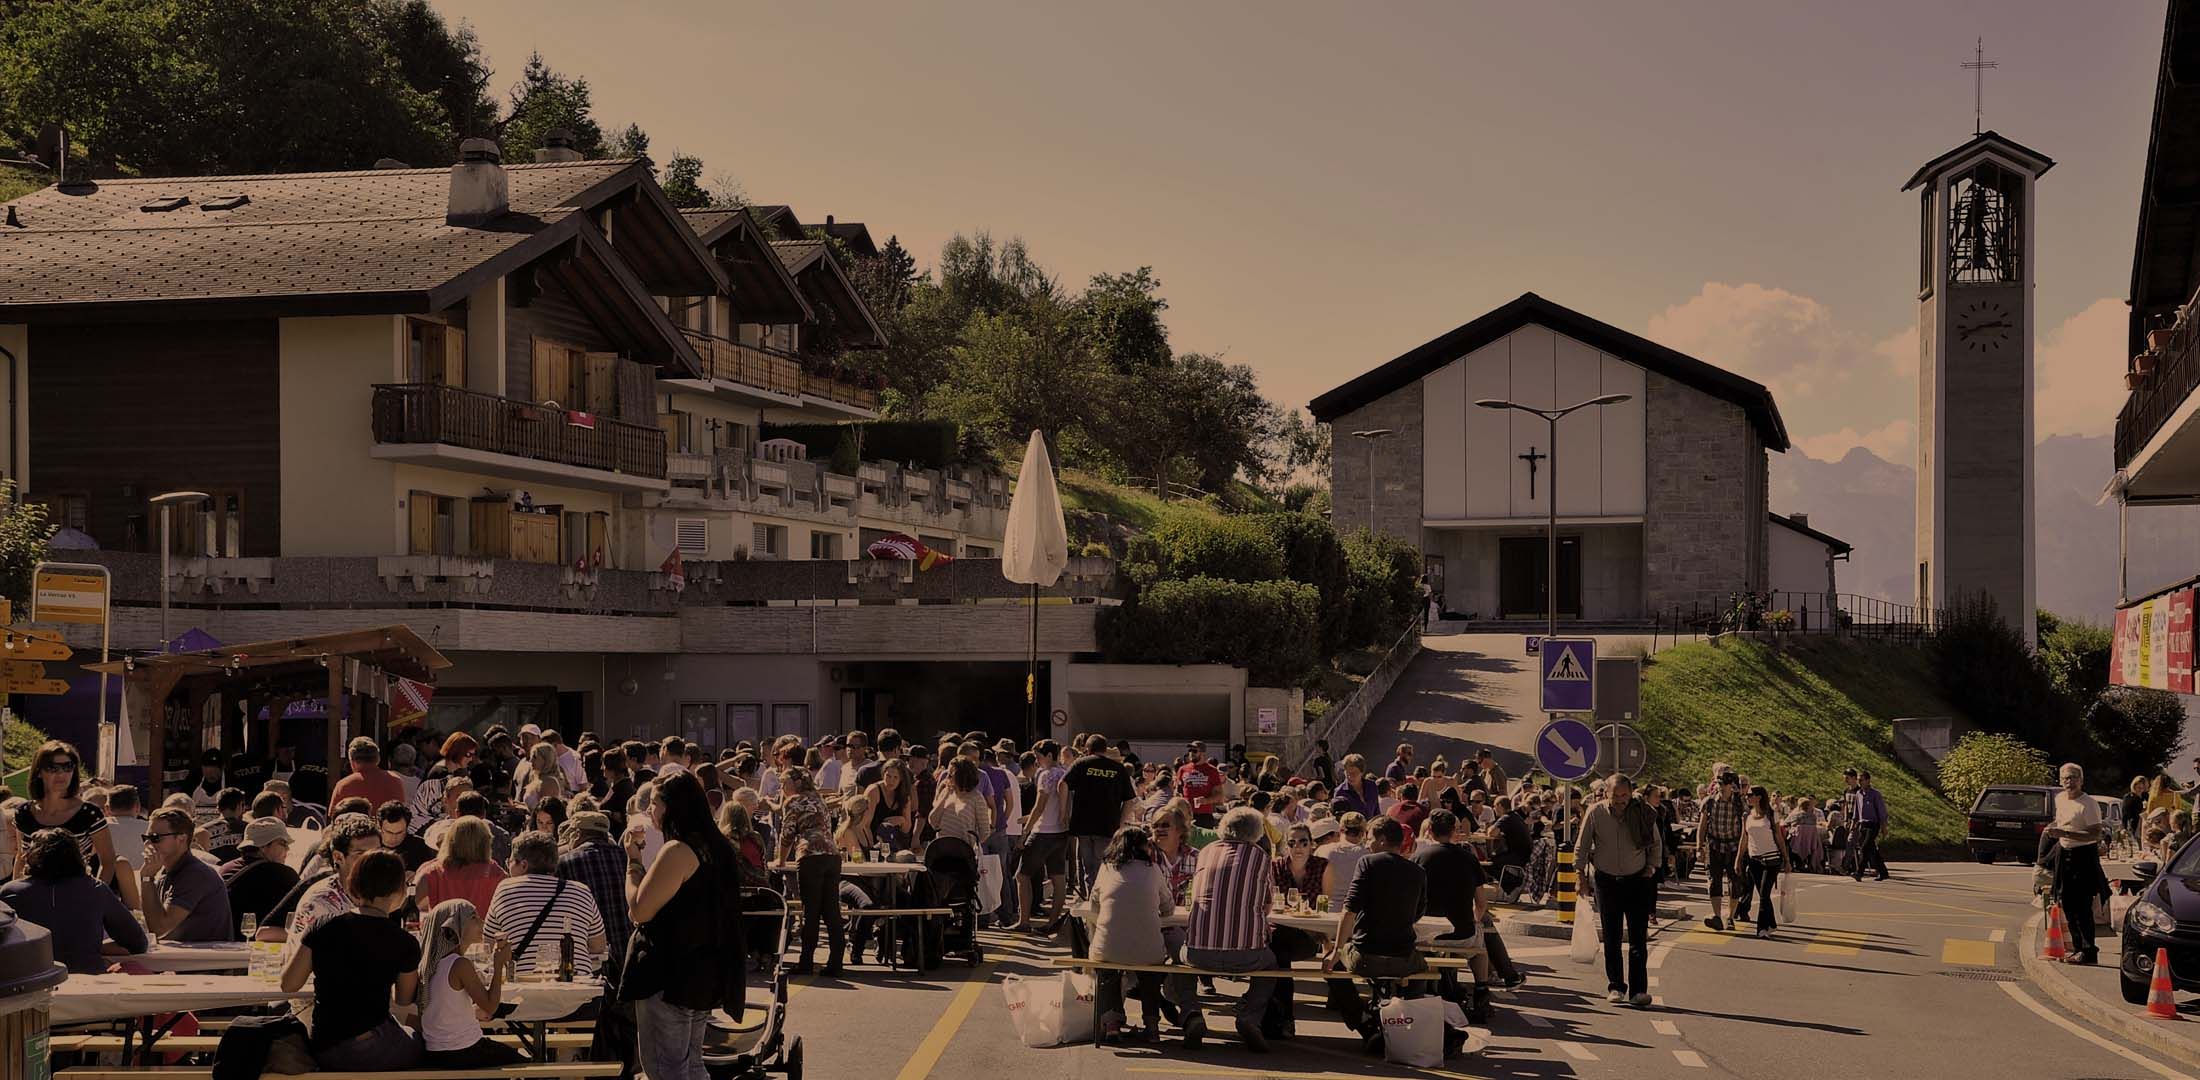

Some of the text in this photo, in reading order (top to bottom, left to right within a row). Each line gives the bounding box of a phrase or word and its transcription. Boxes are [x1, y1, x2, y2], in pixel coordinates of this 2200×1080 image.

[1086, 767, 1118, 779] STAFF
[1076, 994, 1094, 1003] ALI
[1383, 1017, 1414, 1025] IGRO
